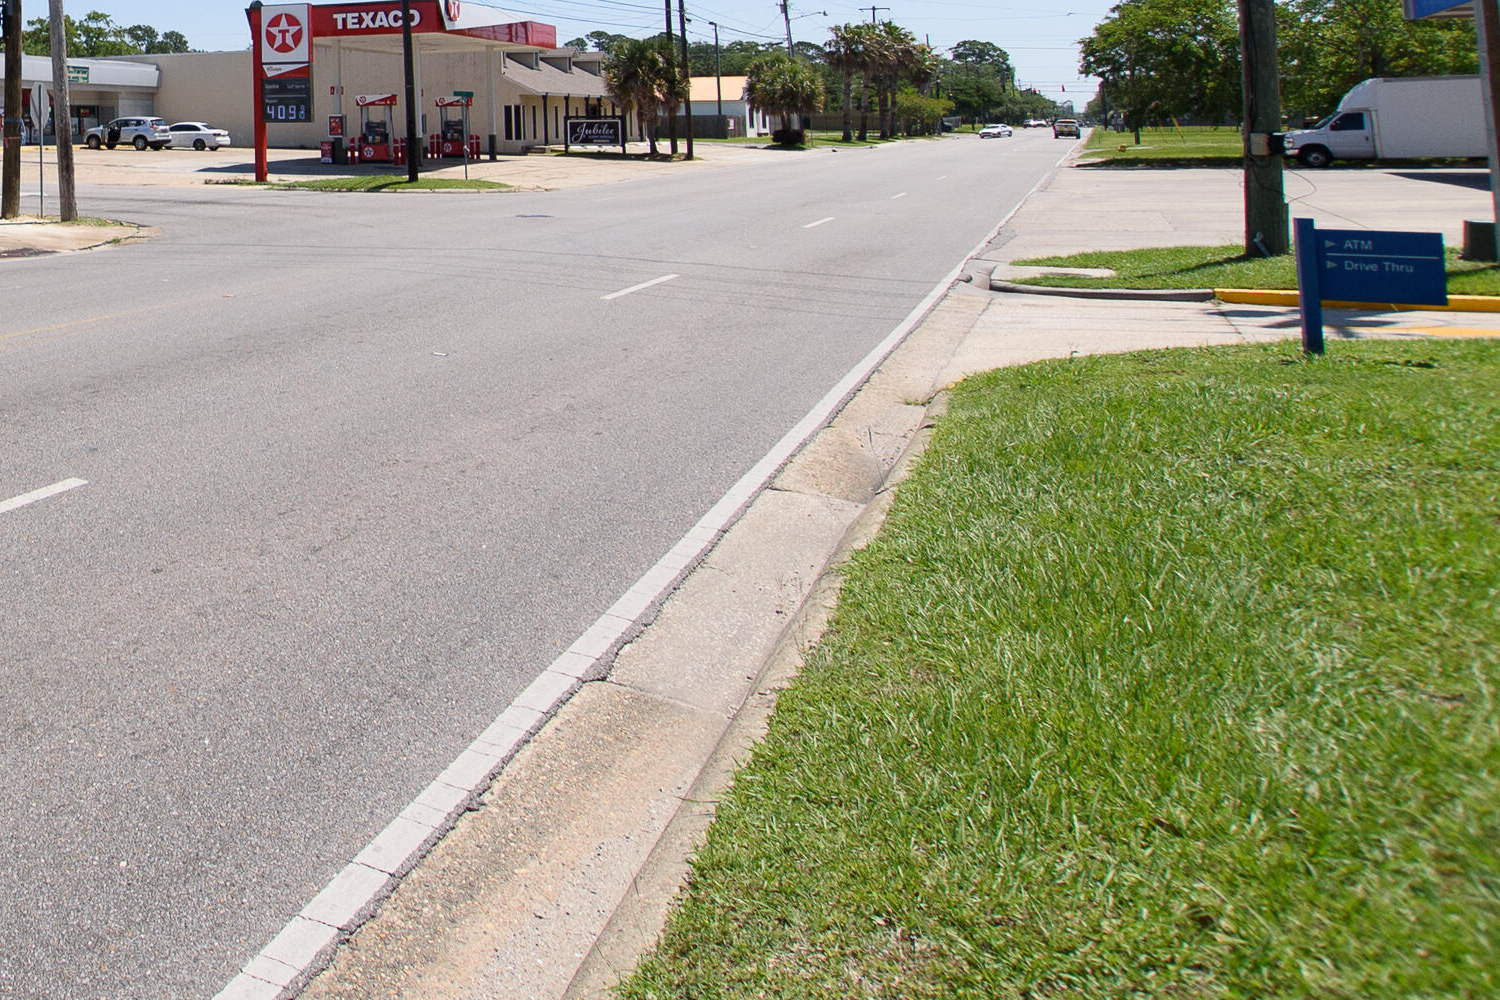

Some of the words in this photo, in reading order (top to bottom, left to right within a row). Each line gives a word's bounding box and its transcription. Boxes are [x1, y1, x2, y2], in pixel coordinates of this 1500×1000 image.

[333, 9, 420, 30] TEXACO
[1343, 239, 1373, 250] ATM
[1343, 260, 1379, 272] Drive
[1383, 261, 1414, 273] Thru
